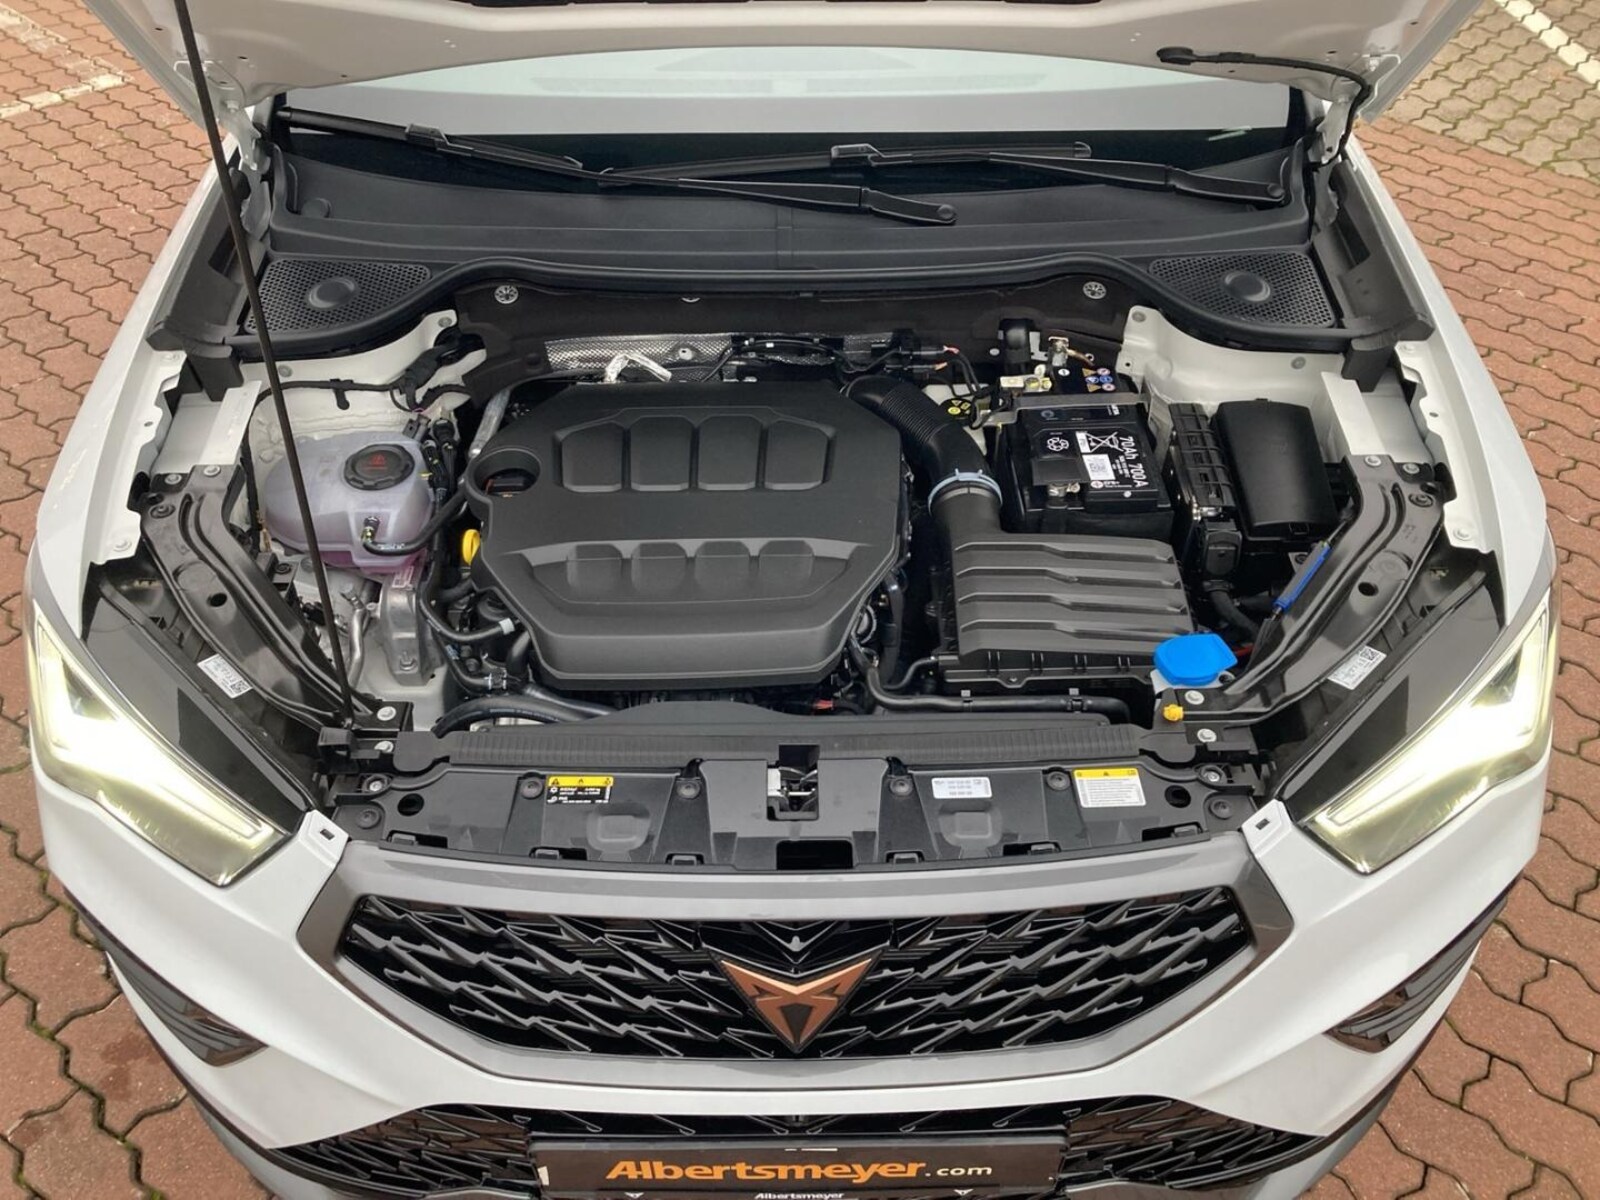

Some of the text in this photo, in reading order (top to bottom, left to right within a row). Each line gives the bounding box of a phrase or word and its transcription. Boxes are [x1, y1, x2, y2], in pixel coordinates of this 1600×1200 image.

[1119, 436, 1139, 460] 70Ah
[1128, 463, 1149, 488] 700A
[754, 1192, 845, 1200] Albertsmeyer
